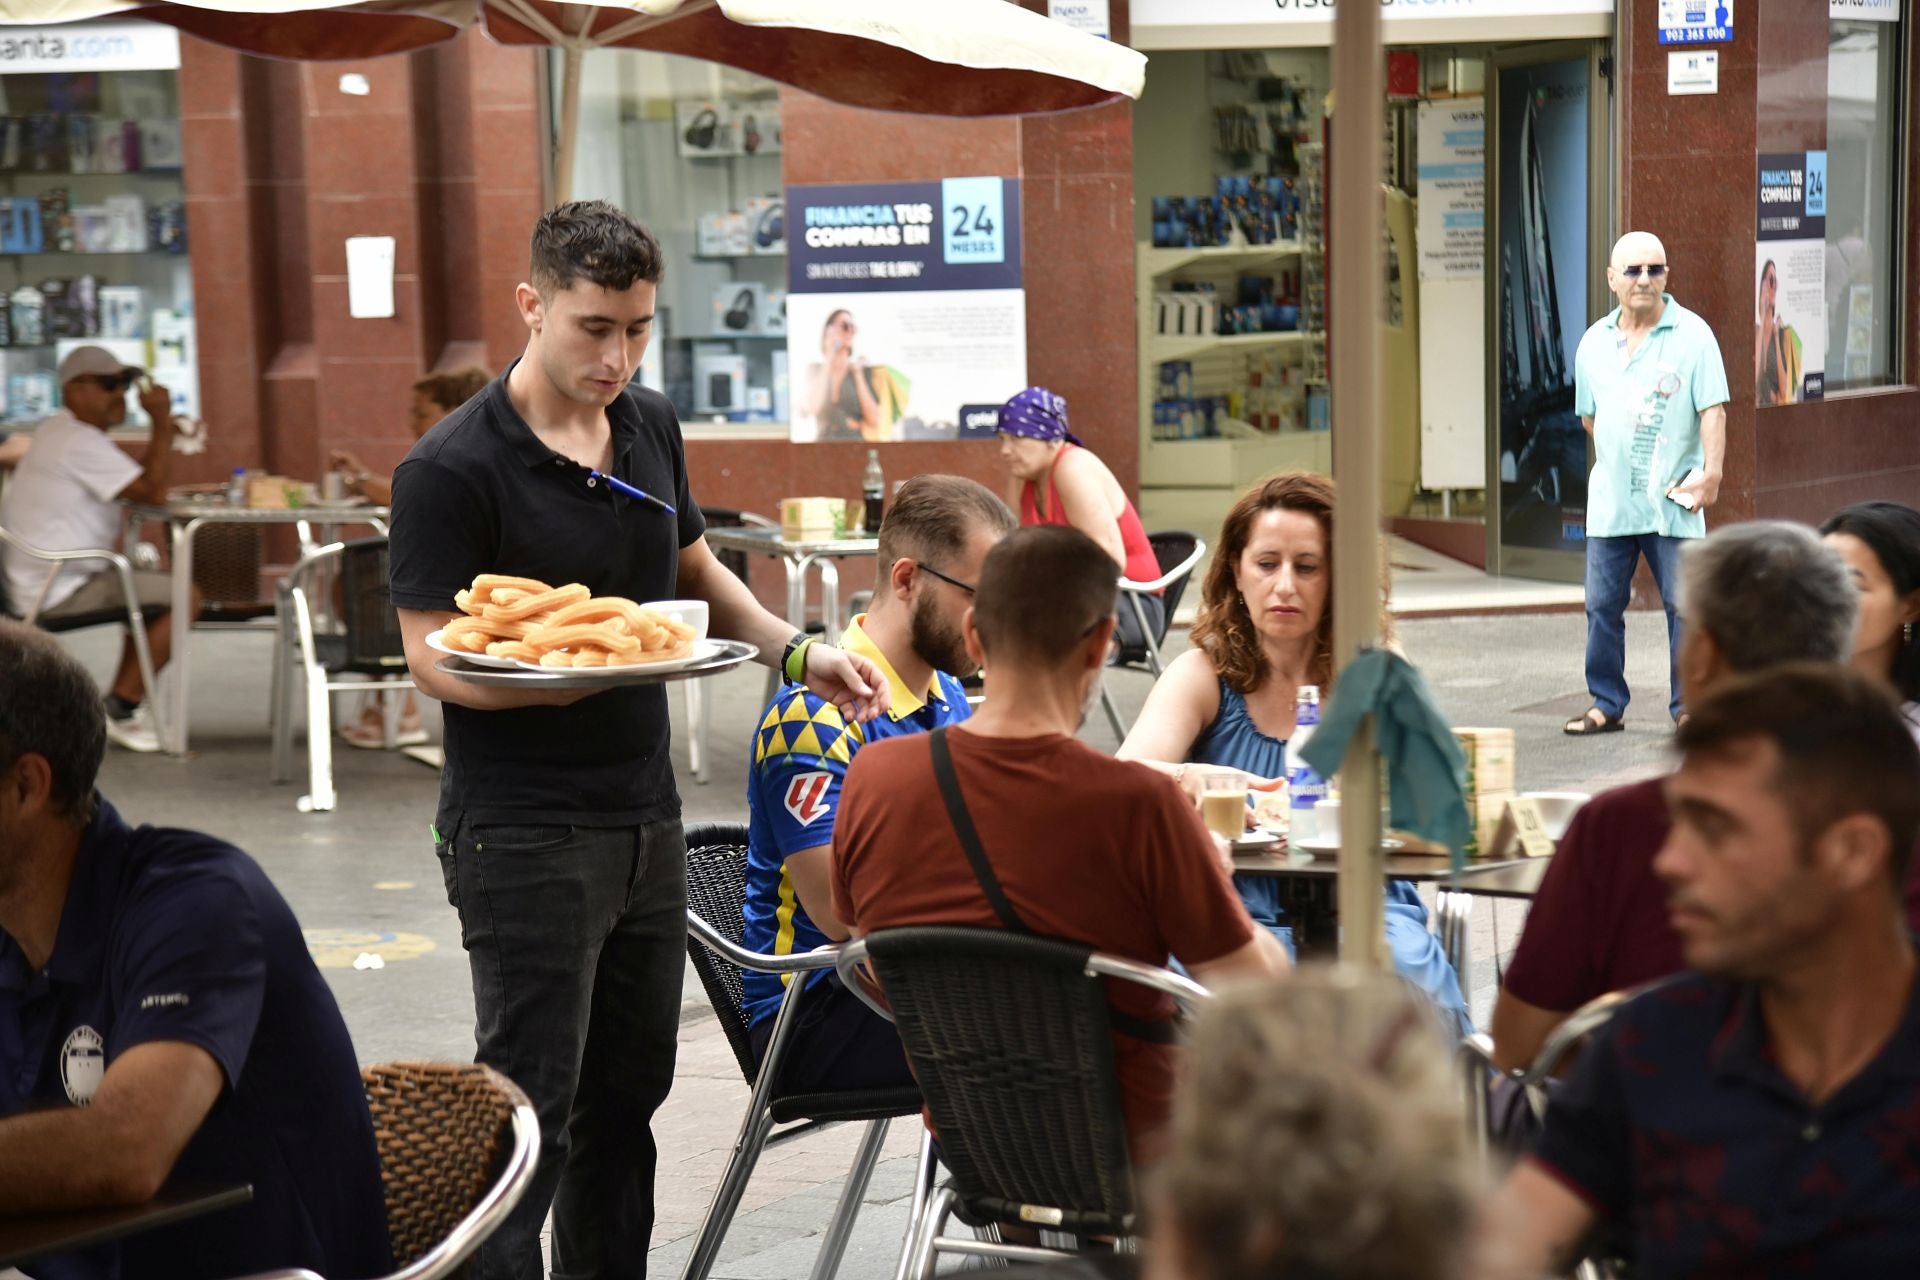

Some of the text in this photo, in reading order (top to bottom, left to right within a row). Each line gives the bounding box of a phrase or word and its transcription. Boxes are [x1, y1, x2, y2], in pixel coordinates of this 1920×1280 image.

[1790, 170, 1802, 186] TUS
[1809, 171, 1822, 197] 24
[805, 202, 933, 226] FINANCIA TUS
[952, 204, 994, 237] 24
[805, 224, 930, 248] COMPRAS EN
